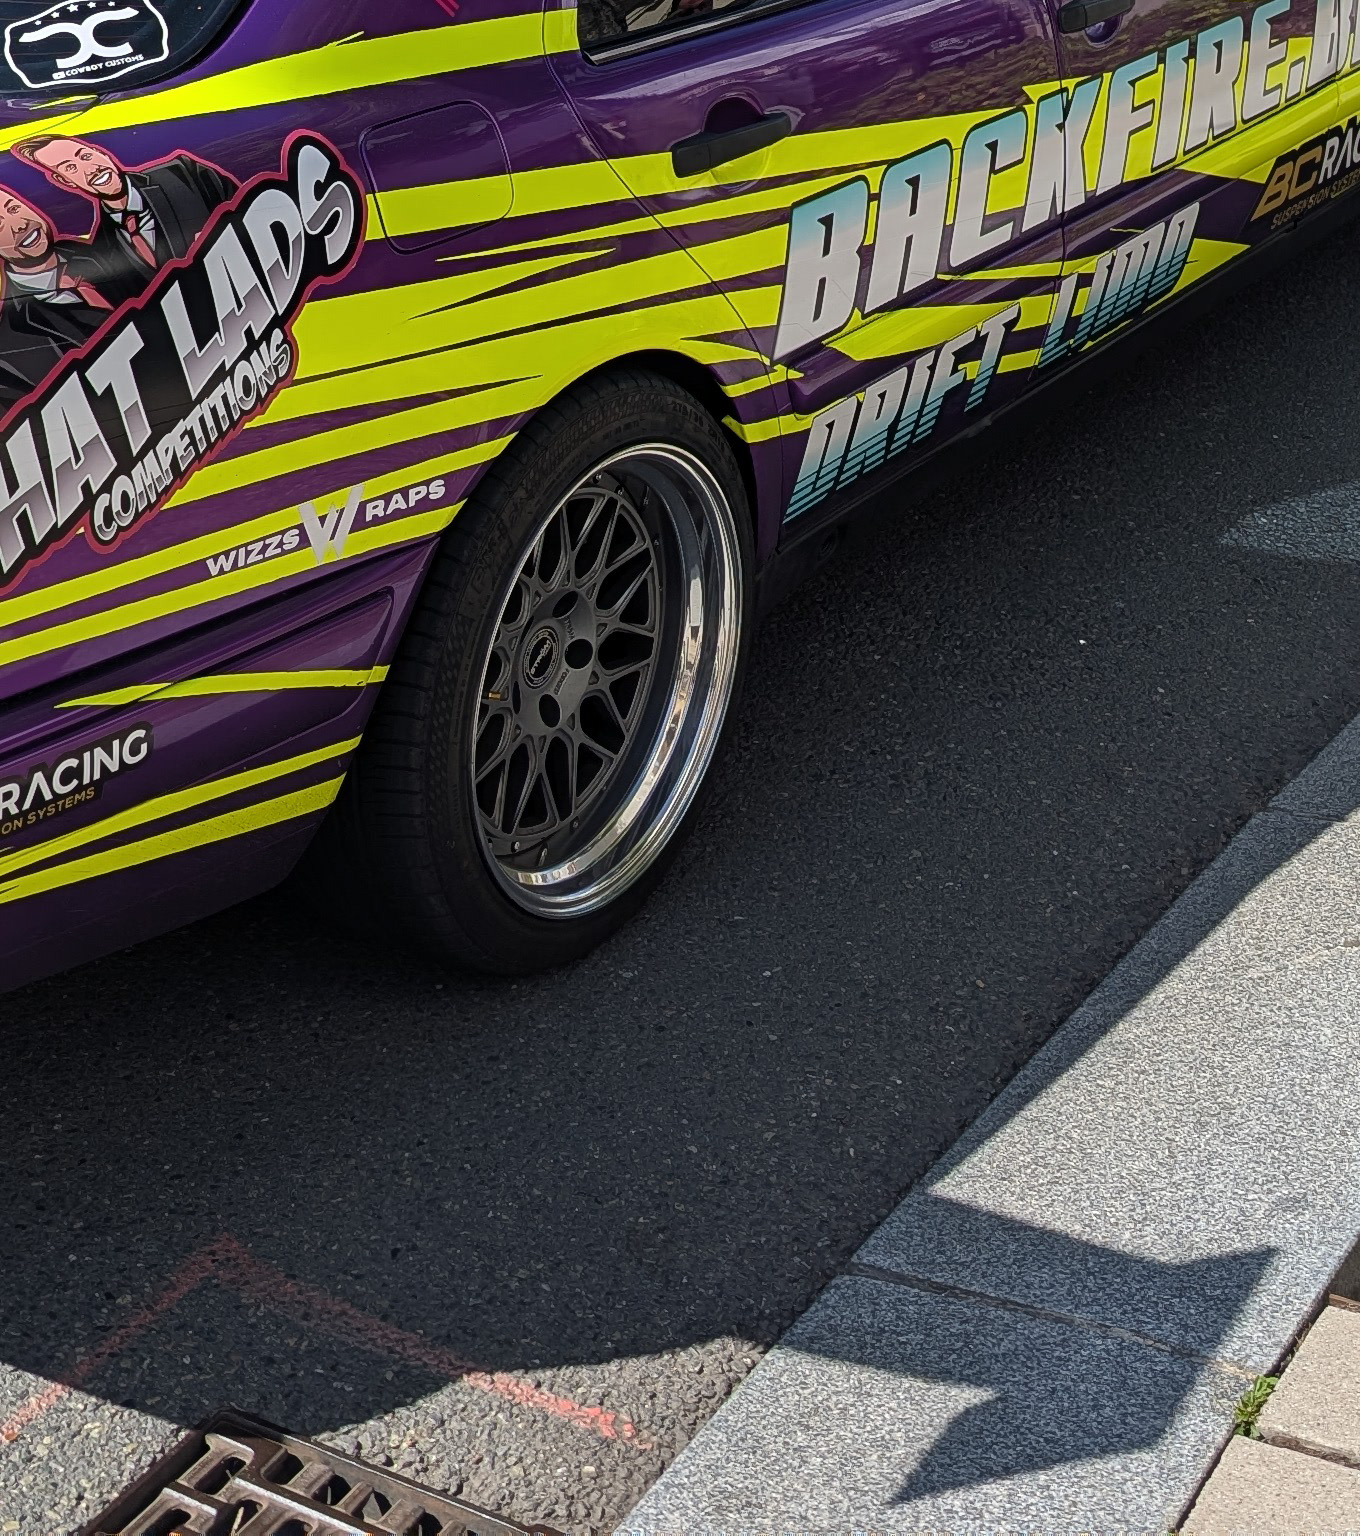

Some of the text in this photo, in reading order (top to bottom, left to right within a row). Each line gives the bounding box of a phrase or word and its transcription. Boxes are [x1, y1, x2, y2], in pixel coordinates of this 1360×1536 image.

[65, 53, 145, 77] COWBOY CUSTOMS
[159, 143, 354, 398] LADS
[783, 202, 1202, 524] DRIFT LIMO
[89, 330, 293, 544] COMPETITIONS
[206, 527, 301, 578] WIZZS
[26, 786, 96, 826] SYSTEMS
